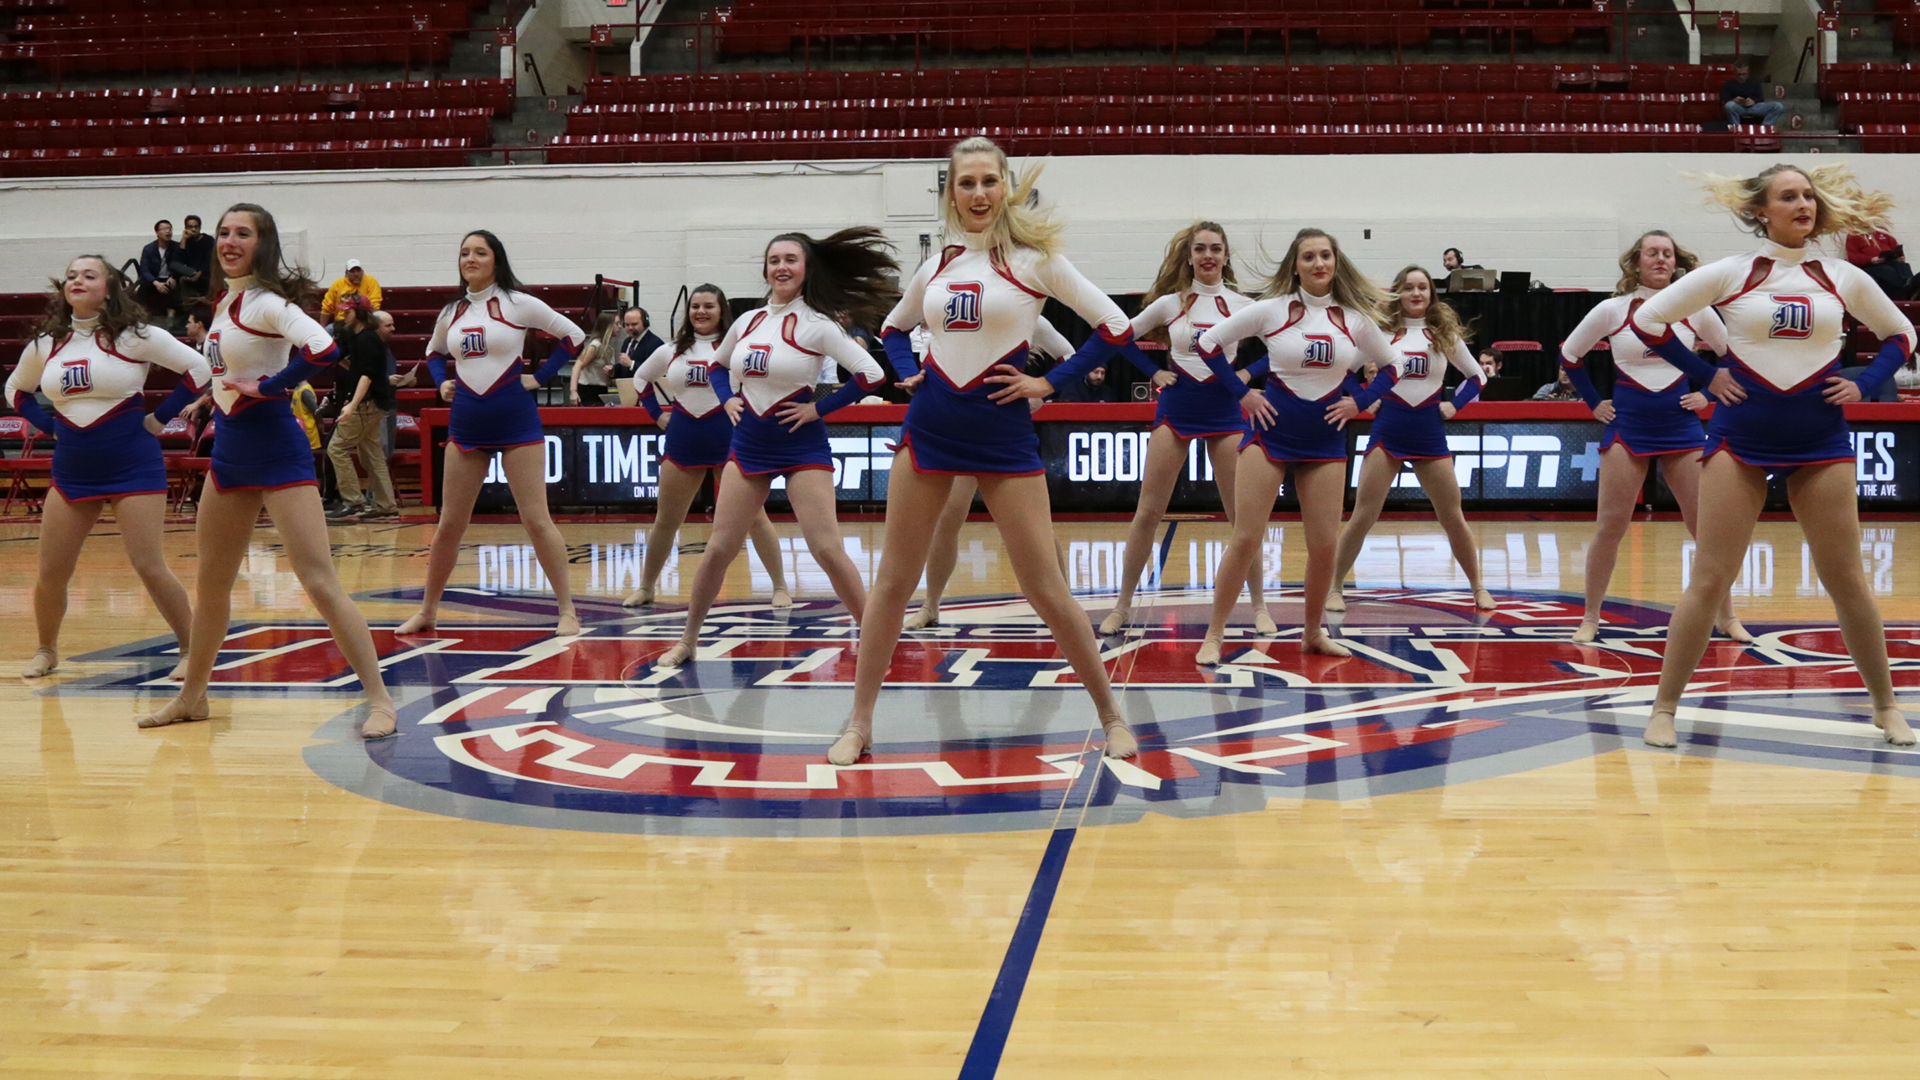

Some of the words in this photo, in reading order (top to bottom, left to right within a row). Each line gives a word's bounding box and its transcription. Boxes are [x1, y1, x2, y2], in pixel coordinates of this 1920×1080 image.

[1723, 20, 1730, 28] 3
[1826, 21, 1833, 29] 4
[599, 34, 606, 42] 3
[1775, 85, 1785, 98] D
[548, 98, 557, 111] D
[1791, 114, 1801, 129] C
[1863, 484, 1878, 496] THE
[1880, 484, 1897, 496] AVE
